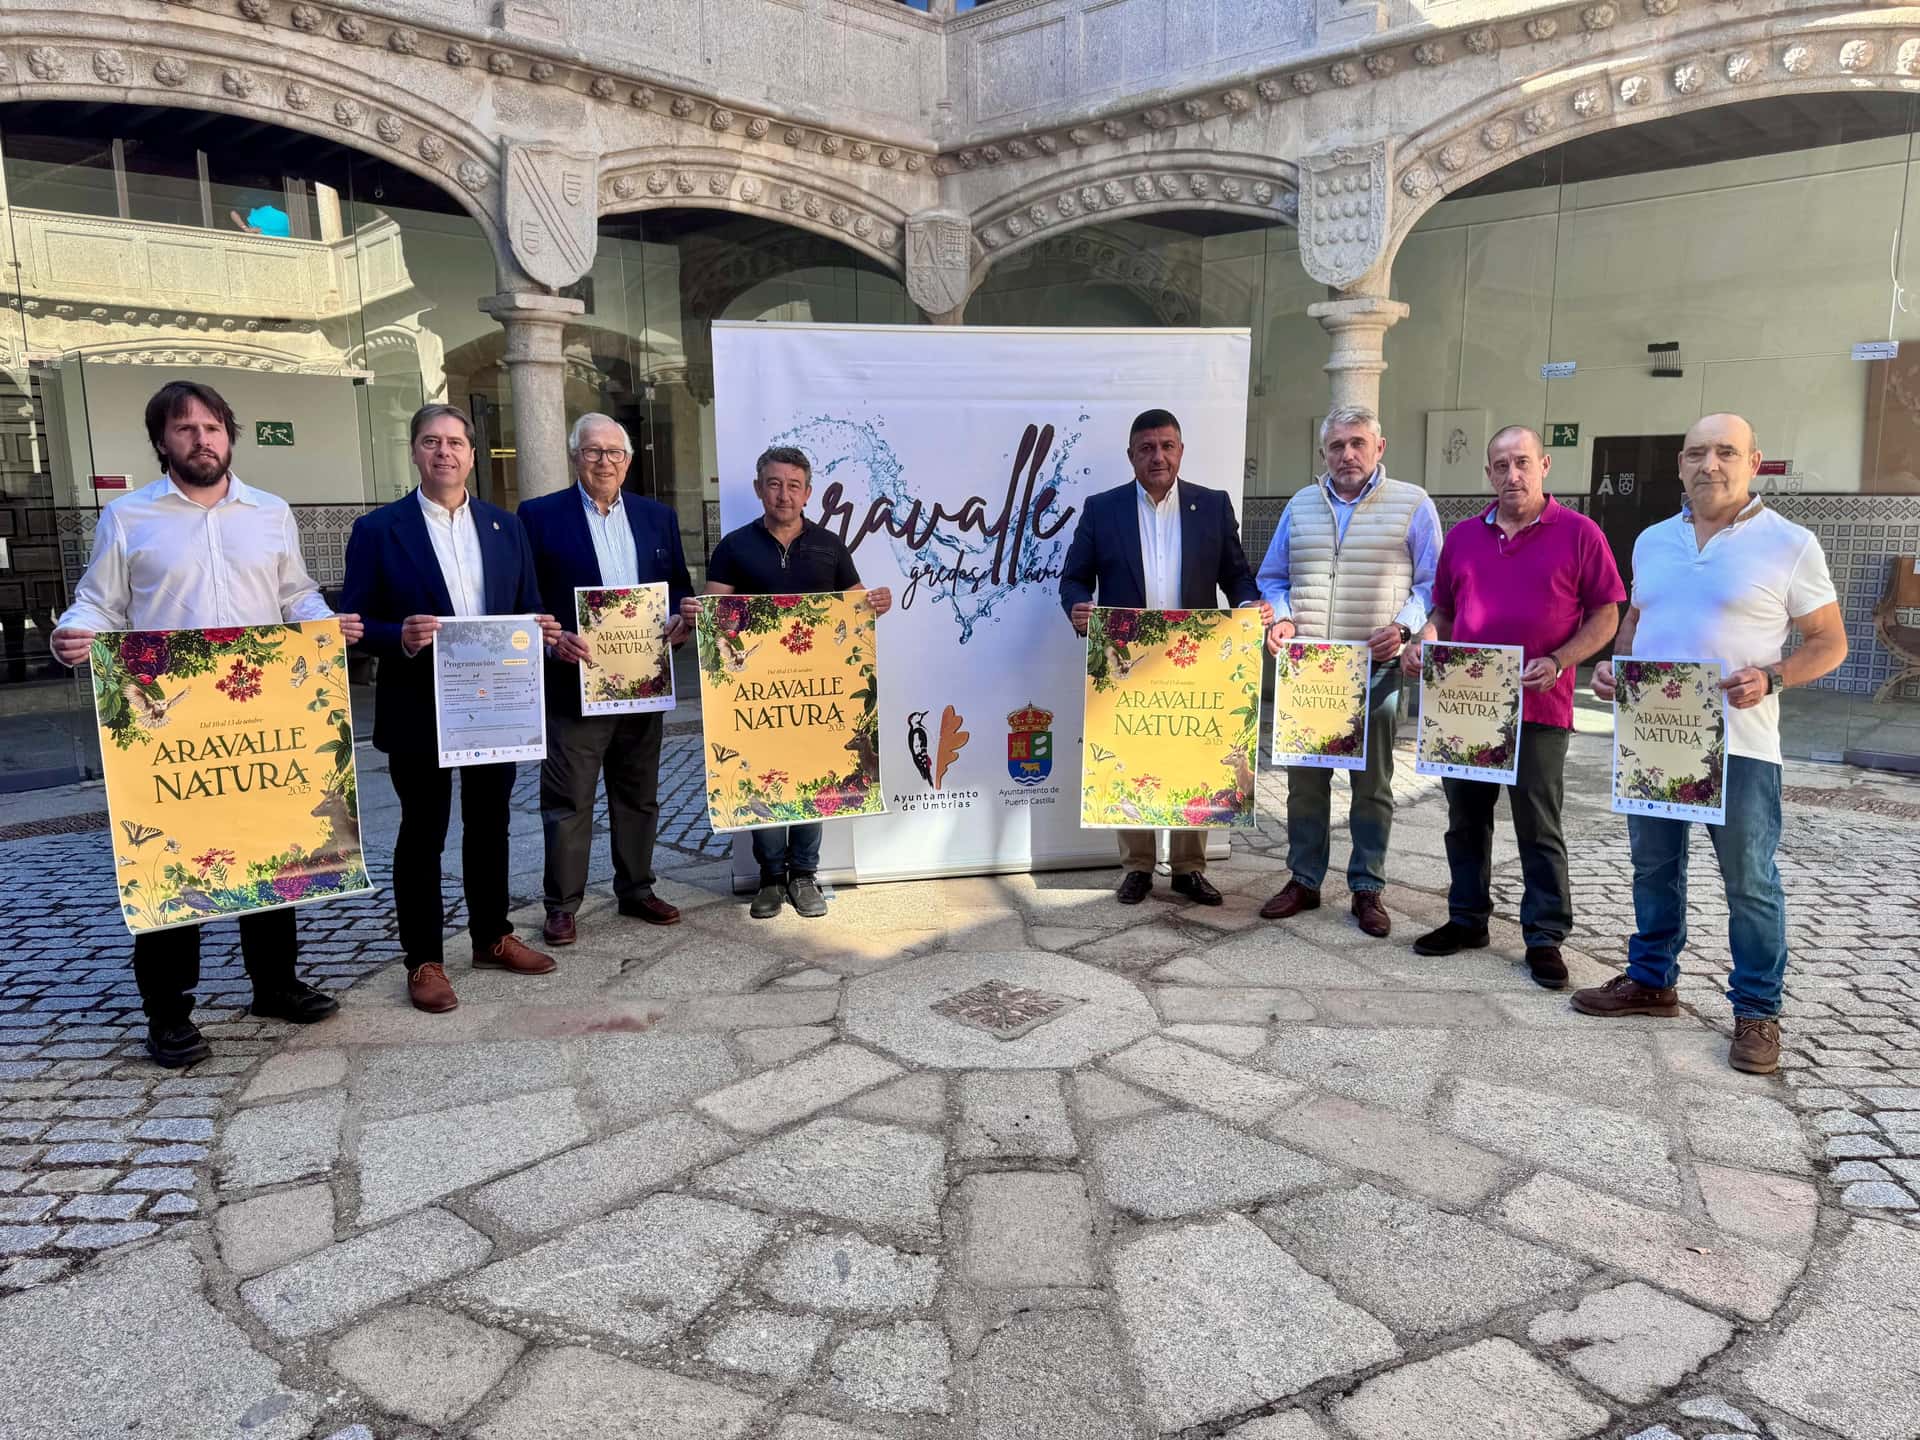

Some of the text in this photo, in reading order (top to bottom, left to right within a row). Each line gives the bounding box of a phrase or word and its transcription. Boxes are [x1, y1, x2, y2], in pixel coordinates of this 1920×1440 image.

[817, 424, 1075, 585] ravalle
[902, 550, 1064, 609] gredos avi
[597, 629, 652, 641] ARAVALLE
[597, 641, 653, 655] NATURA
[734, 677, 844, 701] ARAVALLE
[1293, 684, 1349, 695] ARAVALLE
[1438, 689, 1500, 702] ARAVALLE
[1115, 691, 1224, 709] ARAVALLE
[1292, 696, 1348, 710] NATURA
[734, 702, 844, 731] NATURA
[1438, 701, 1499, 718] NATURA
[1114, 714, 1223, 737] NATURA
[1634, 711, 1702, 727] ARAVALLE
[1634, 727, 1702, 745] NATURA
[152, 727, 307, 766] ARAVALLE
[153, 758, 310, 803] NATURA
[288, 784, 311, 796] 2025
[894, 791, 978, 803] Ayuntamiento
[998, 787, 1048, 796] Ayuntamiento
[902, 802, 916, 811] de
[1030, 797, 1055, 805] Castilla
